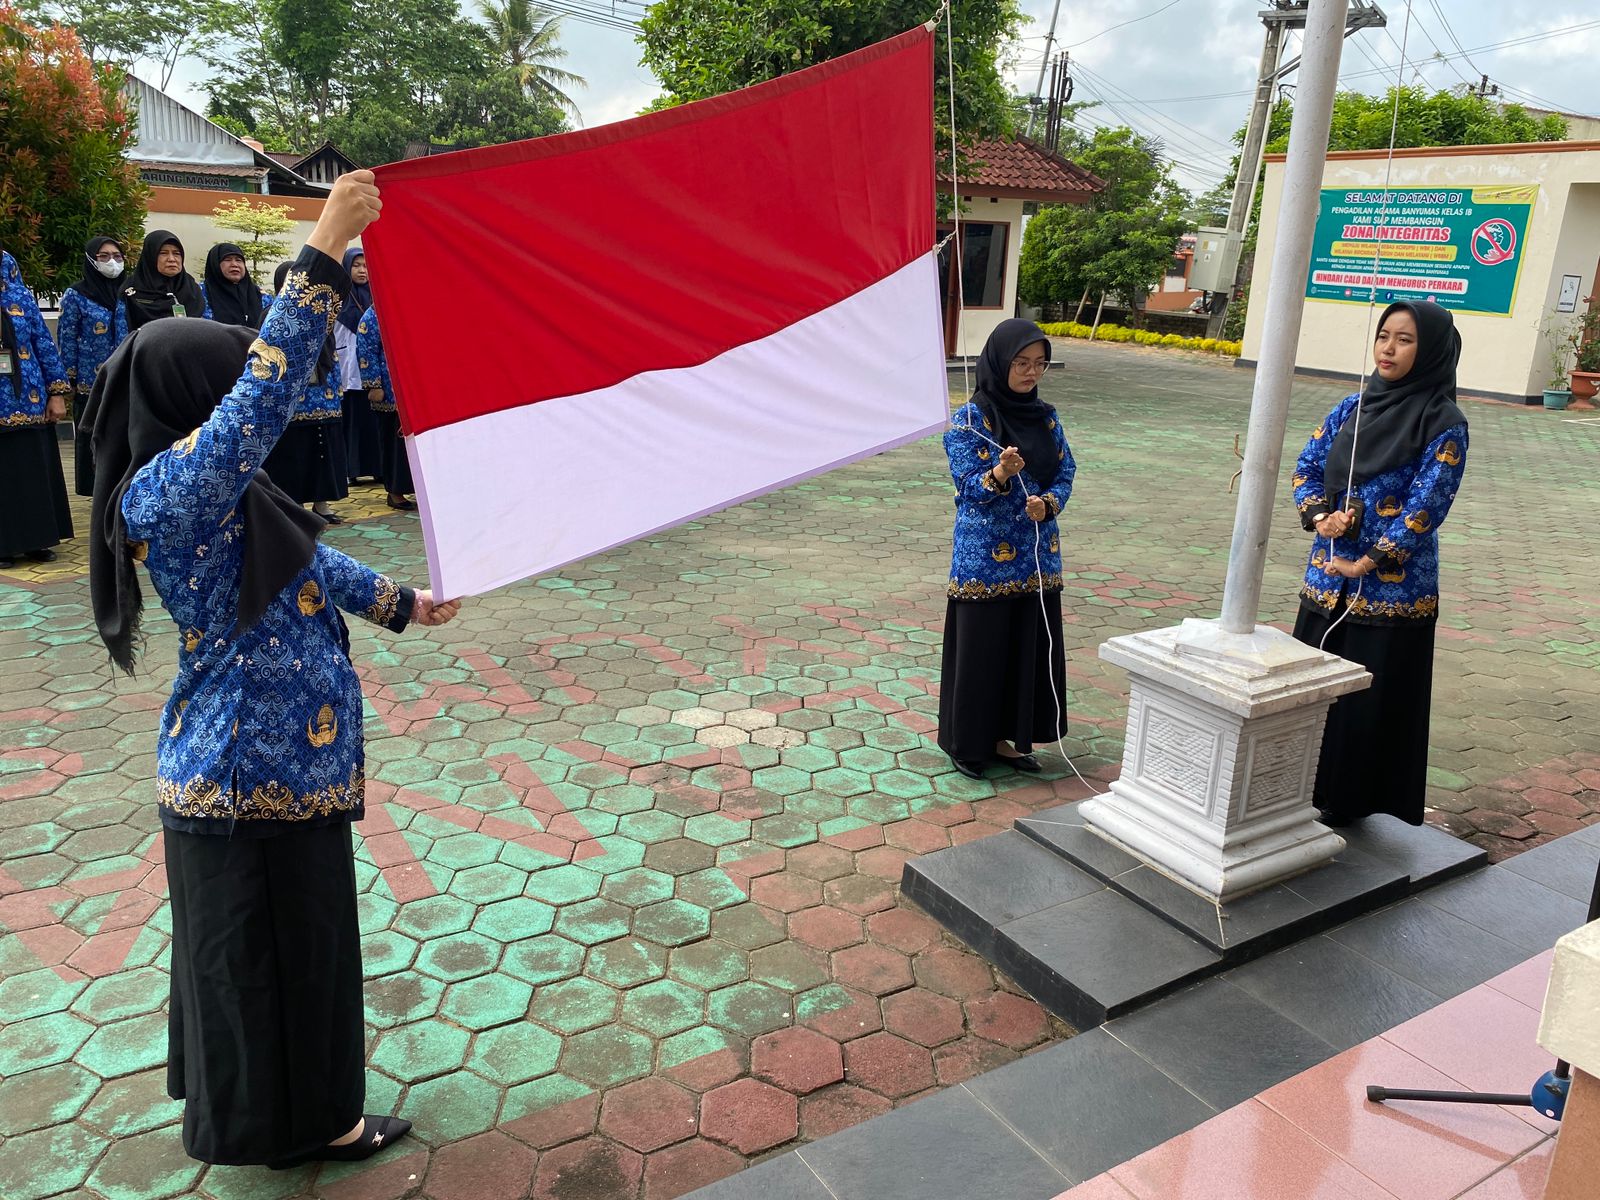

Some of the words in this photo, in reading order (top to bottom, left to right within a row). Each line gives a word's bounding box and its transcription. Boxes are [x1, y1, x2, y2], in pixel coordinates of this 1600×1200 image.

[139, 172, 183, 183] ARUNG
[186, 176, 229, 187] MAKAN
[1345, 193, 1396, 203] SELAMAT
[1398, 193, 1446, 204] DATANG
[1448, 193, 1462, 204] DI
[1374, 207, 1400, 215] AGAMA
[1441, 208, 1463, 216] KELAS
[1353, 216, 1371, 224] KAMI
[1373, 216, 1389, 224] SIAP
[1391, 217, 1444, 225] MEMBANGUN
[1342, 226, 1374, 239] ZONA
[1375, 227, 1450, 241] INTEGRITAS
[1315, 273, 1343, 283] HINDARI
[1344, 274, 1361, 284] CALO
[1386, 277, 1427, 288] MENGURUS
[1428, 280, 1463, 291] PERKARA
